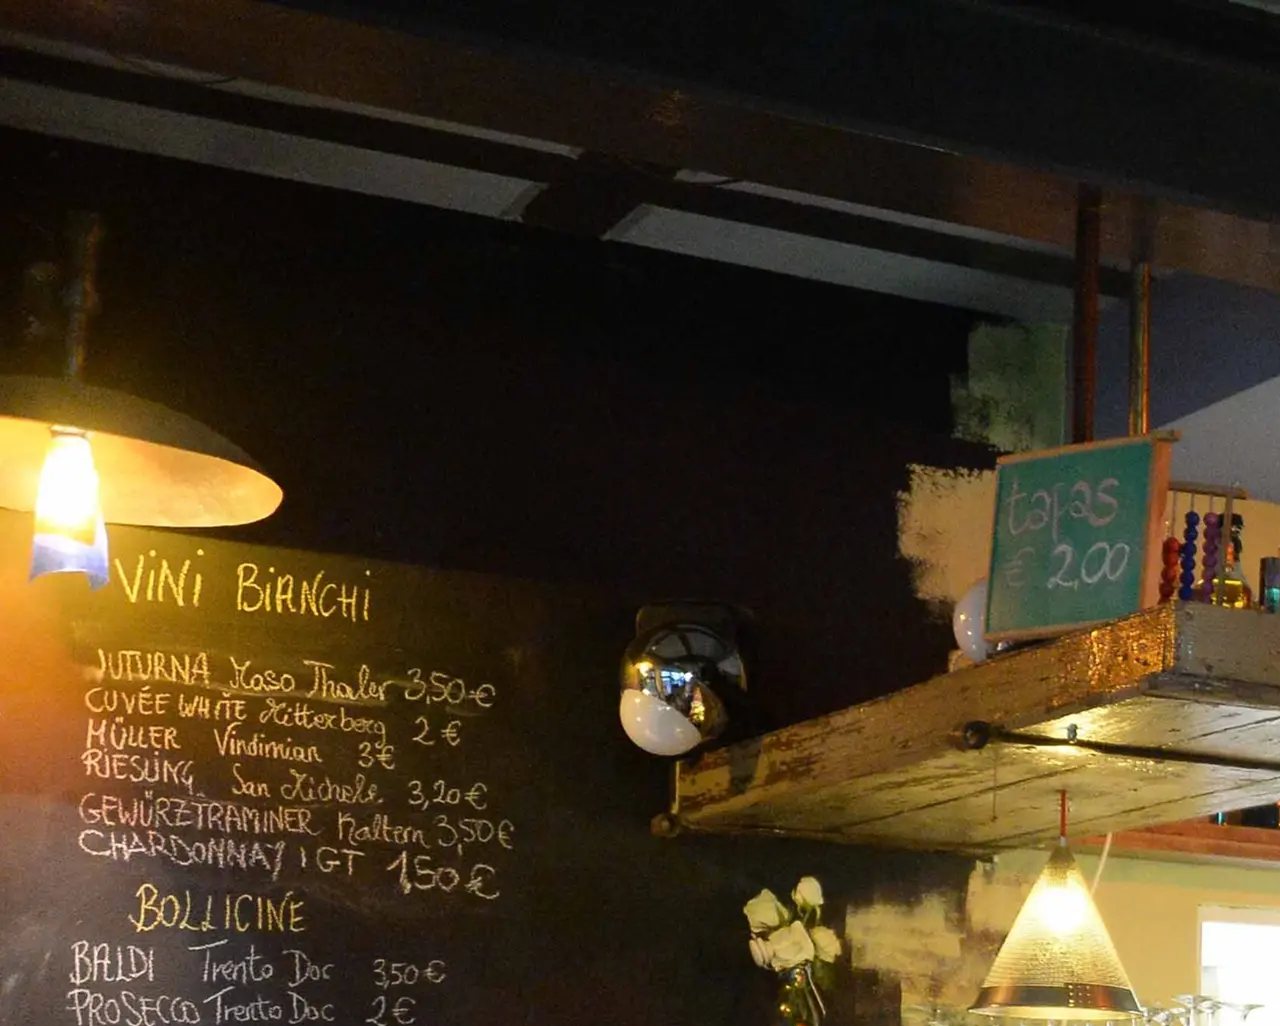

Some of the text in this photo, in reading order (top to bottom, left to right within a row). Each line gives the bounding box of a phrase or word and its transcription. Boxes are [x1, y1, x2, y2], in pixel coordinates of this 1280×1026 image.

[1004, 478, 1120, 542] tapas
[1047, 542, 1130, 589] 2,00
[84, 685, 170, 715] CUVÉE
[231, 763, 271, 798] San
[78, 829, 285, 881] CHARDONNAY
[128, 883, 306, 932] BOLLICINE
[69, 940, 154, 985] BALDI
[188, 939, 273, 984] Trento
